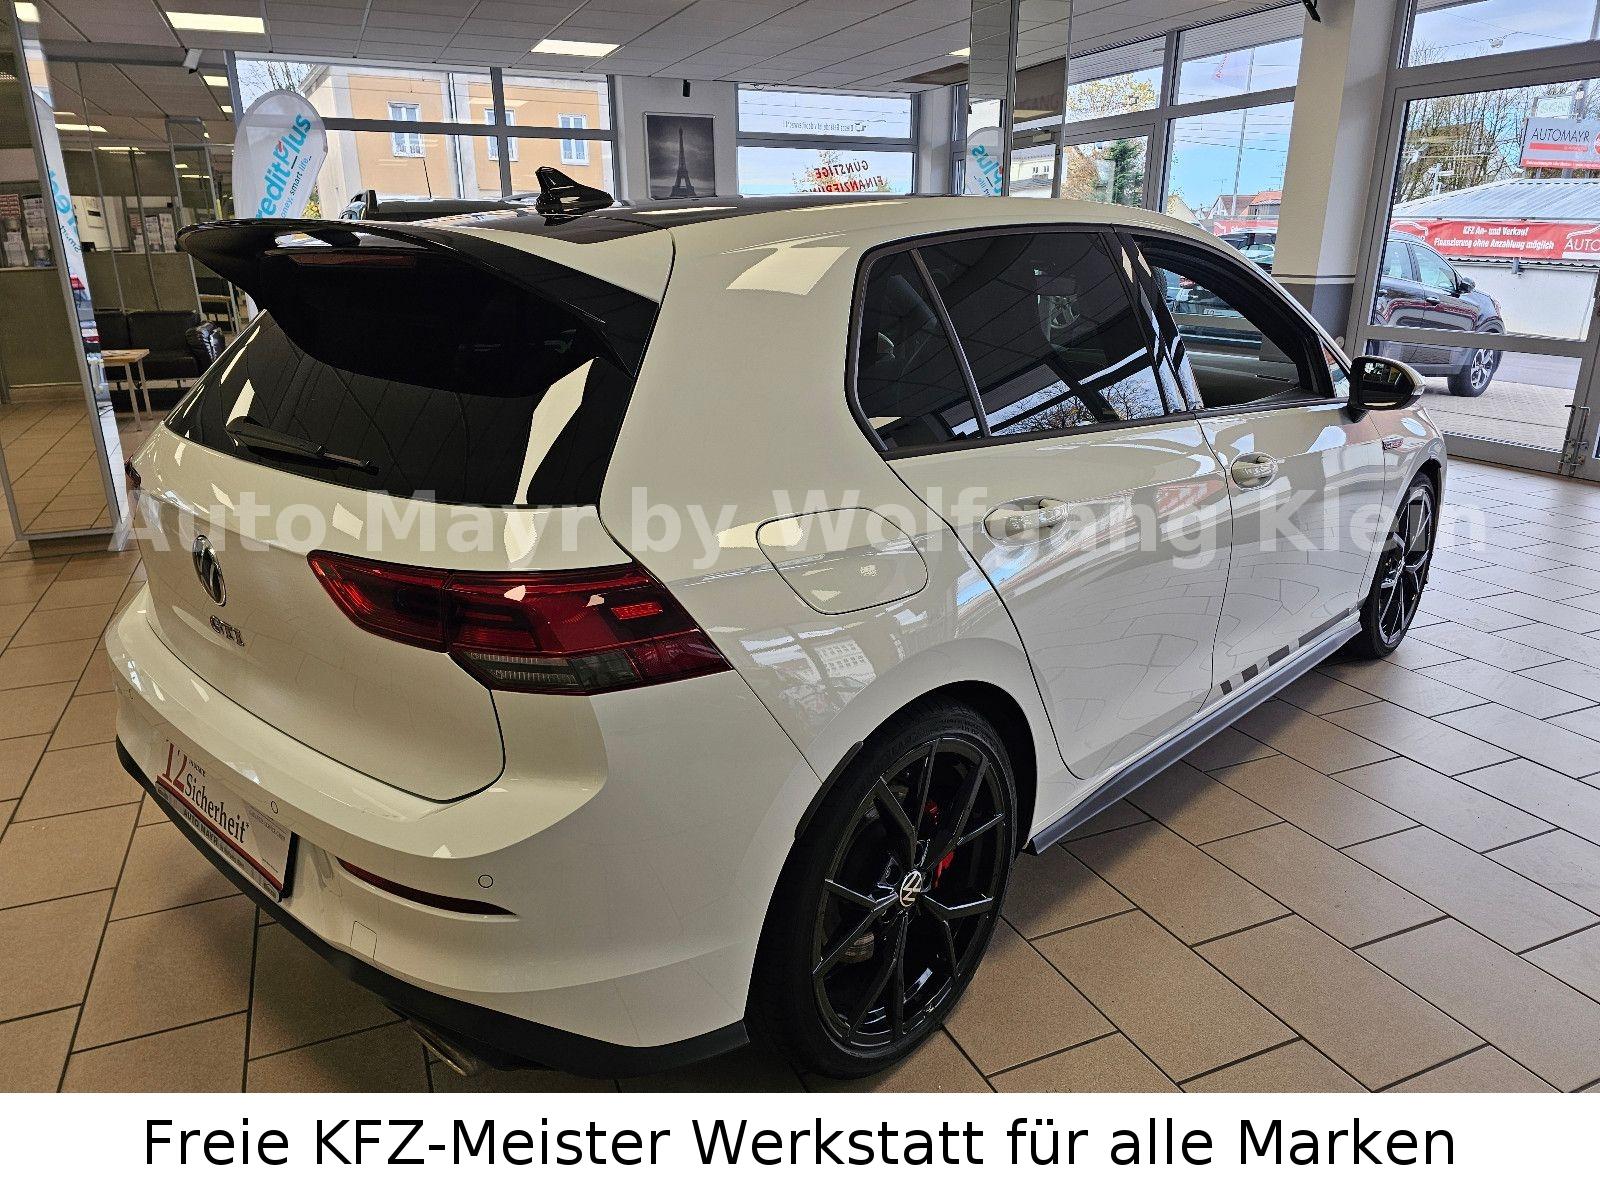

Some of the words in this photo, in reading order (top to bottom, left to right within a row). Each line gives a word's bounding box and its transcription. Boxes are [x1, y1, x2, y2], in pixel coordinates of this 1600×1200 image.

[1531, 128, 1589, 142] AUTOMAYR
[255, 112, 312, 220] reditPlus
[1488, 226, 1501, 235] und
[1502, 227, 1529, 236] Verkauf
[1434, 238, 1472, 248] Finanzierung
[1472, 239, 1489, 248] ohne
[1490, 239, 1524, 250] Anzahlung
[1525, 240, 1555, 250] möglich
